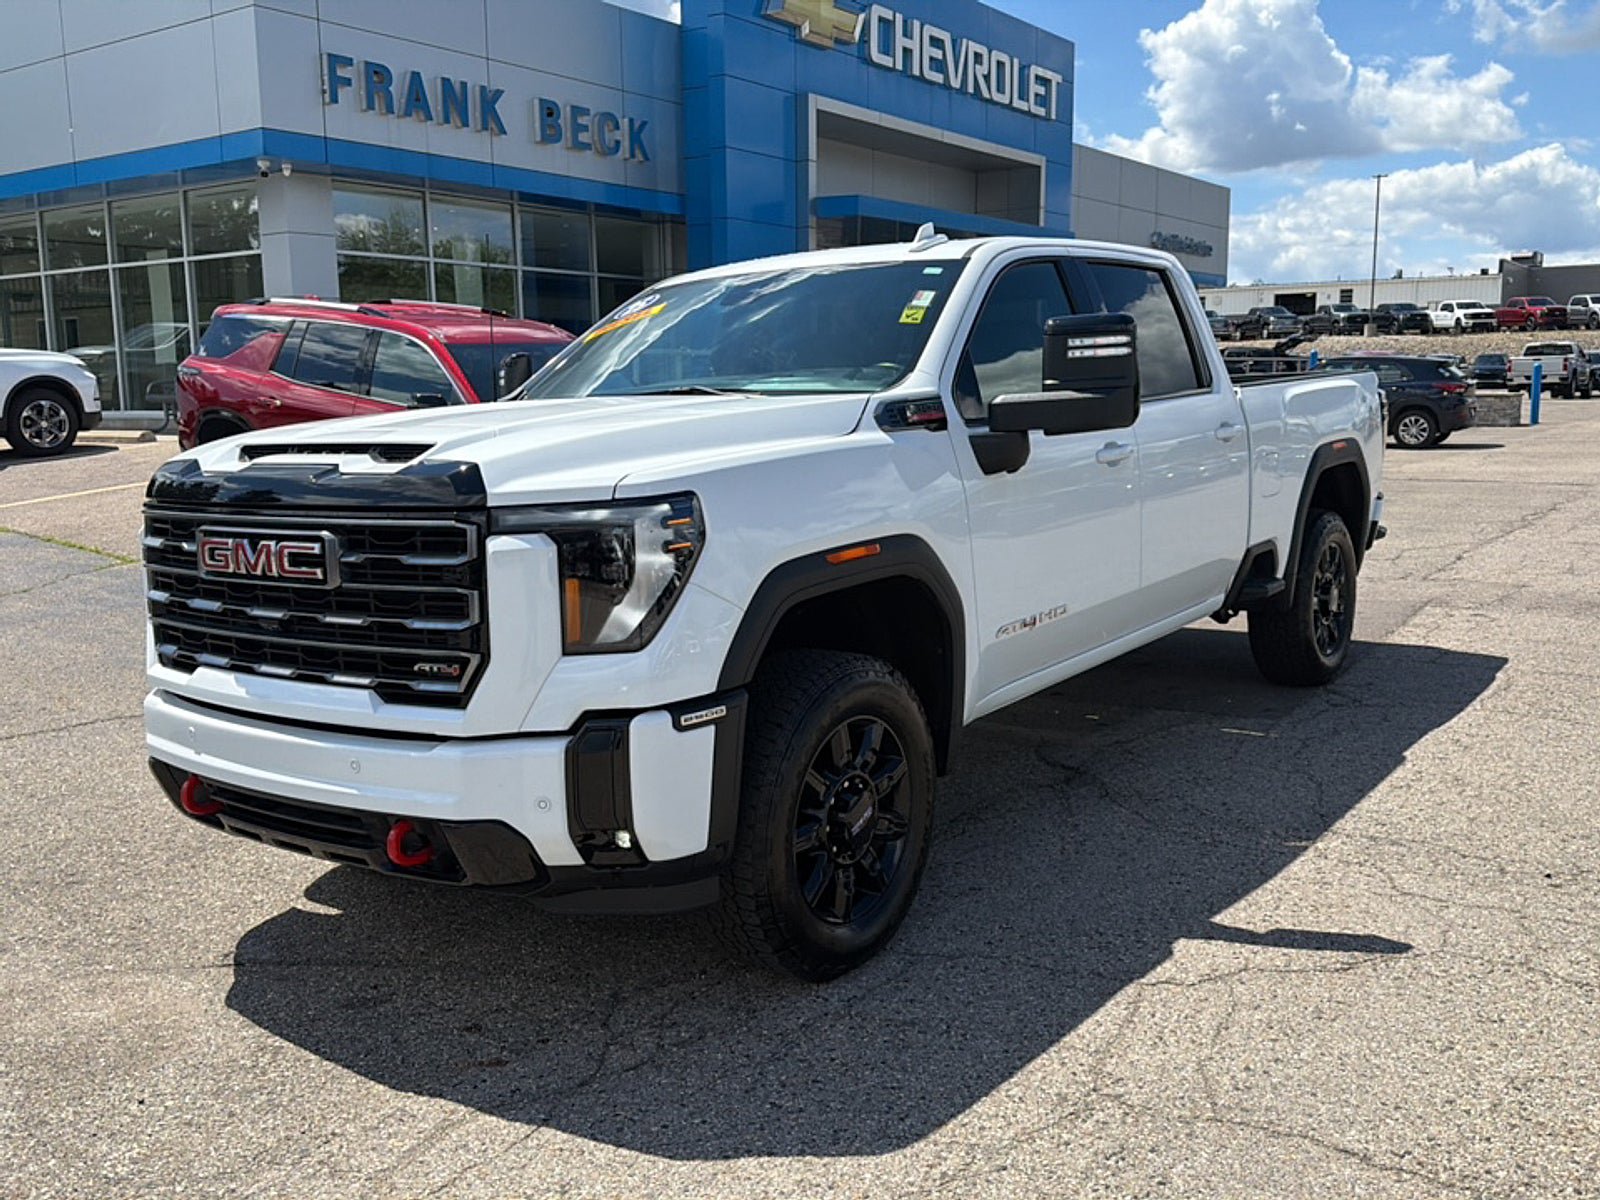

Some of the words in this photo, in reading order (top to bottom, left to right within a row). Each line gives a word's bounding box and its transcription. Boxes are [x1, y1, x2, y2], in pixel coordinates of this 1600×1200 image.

[321, 51, 508, 137] FRANK
[533, 96, 650, 163] BECK
[869, 3, 1064, 121] CHEVROLET
[200, 538, 325, 580] GMC
